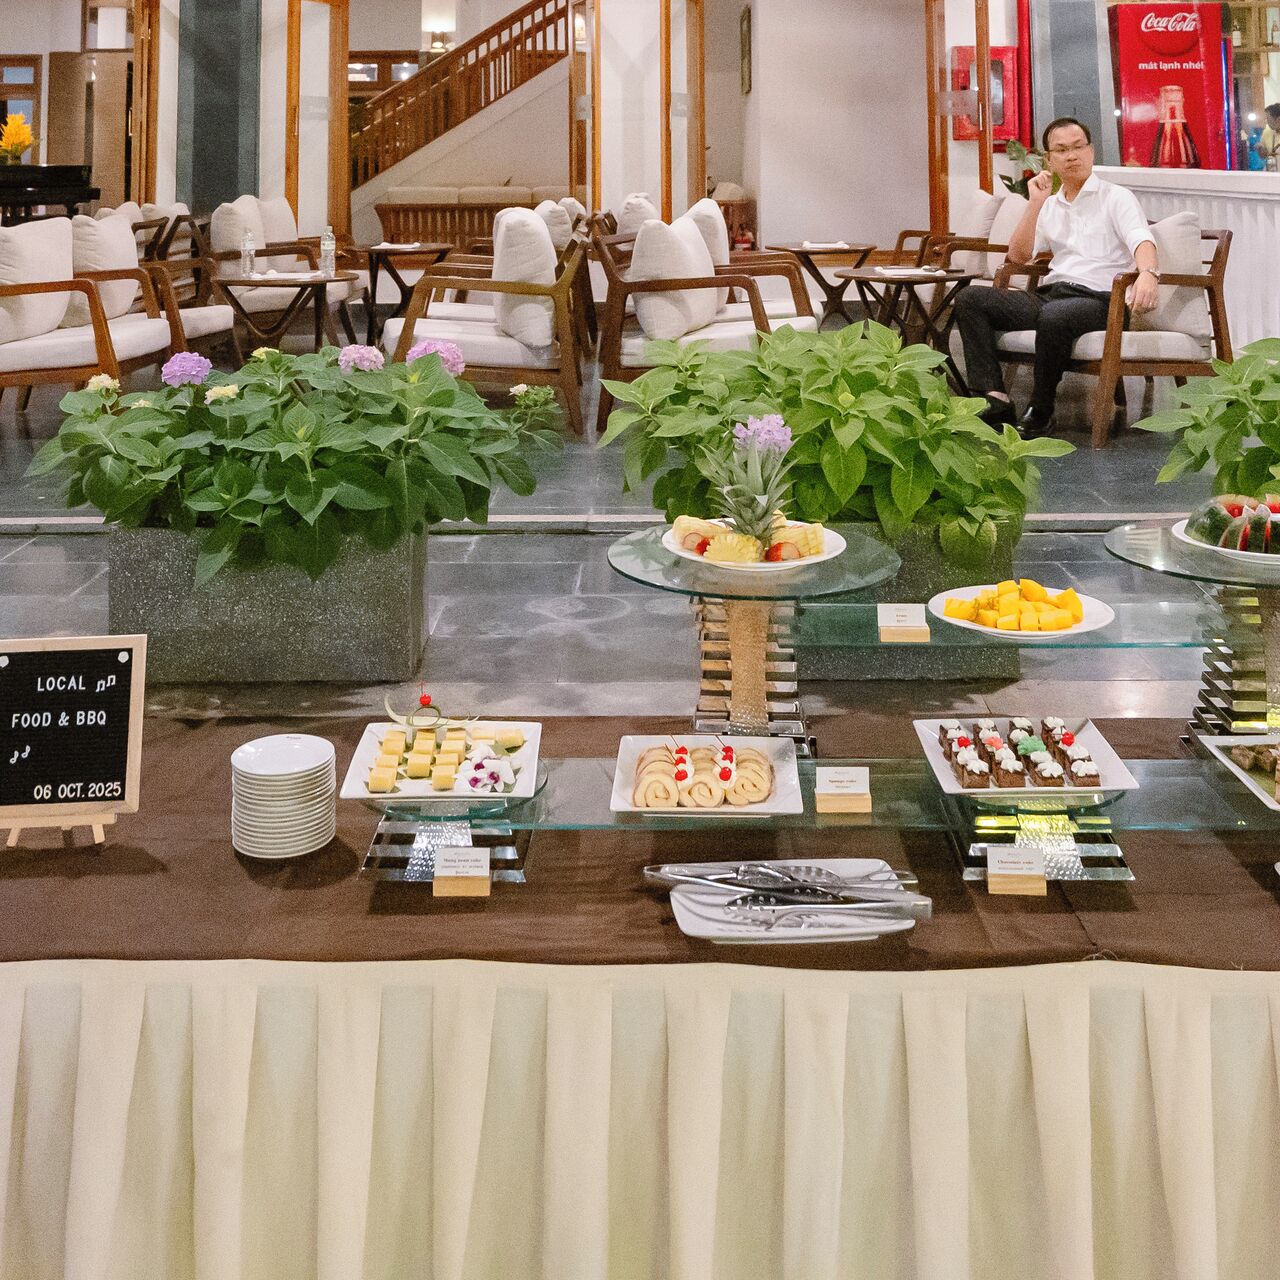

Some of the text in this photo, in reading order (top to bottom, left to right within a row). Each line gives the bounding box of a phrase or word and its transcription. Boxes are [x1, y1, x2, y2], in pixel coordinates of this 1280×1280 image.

[1140, 12, 1199, 32] Coca-Cola
[37, 675, 86, 692] LOCAL
[11, 710, 107, 728] FOOD & BBQ
[33, 784, 52, 800] 06
